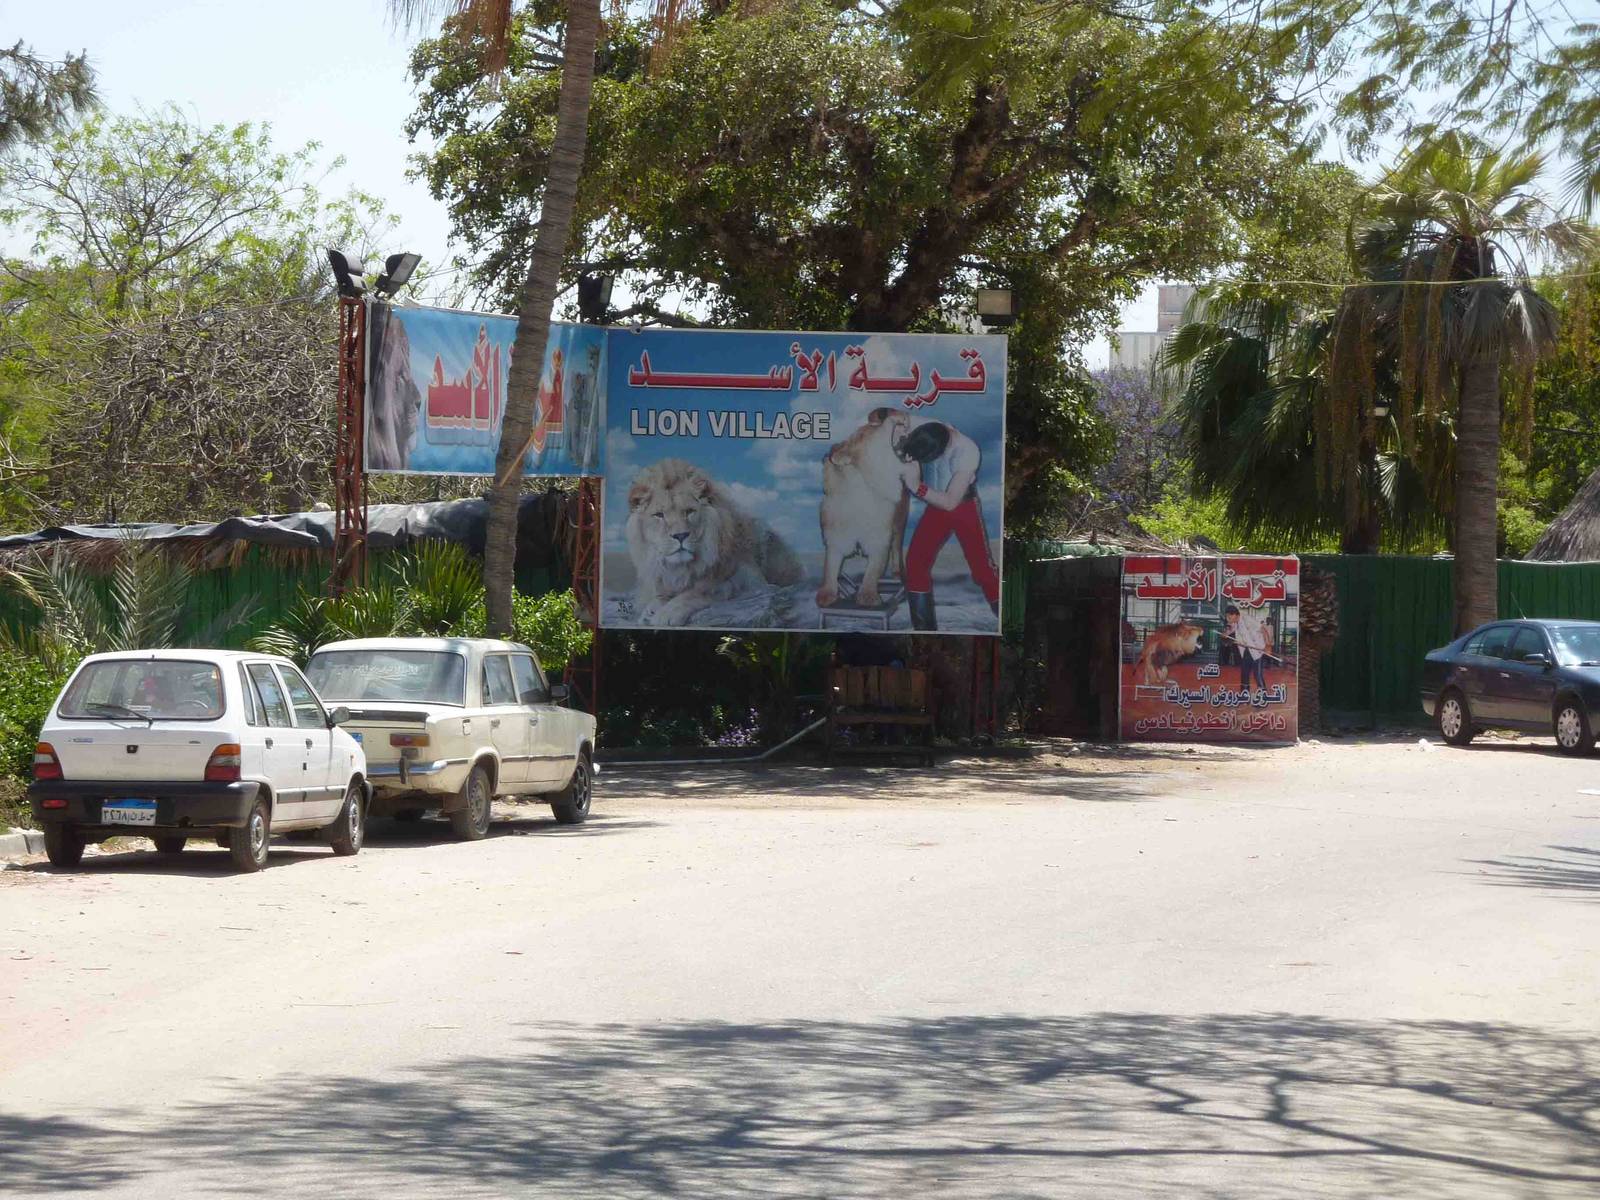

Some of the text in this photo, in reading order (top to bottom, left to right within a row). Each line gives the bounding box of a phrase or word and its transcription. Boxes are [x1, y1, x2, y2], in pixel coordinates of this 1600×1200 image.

[628, 342, 987, 407] قرية الأسد
[630, 408, 831, 440] LION VILLAGE
[1136, 562, 1286, 608] قرية الأسد
[1197, 664, 1220, 679] تقدم
[1166, 685, 1211, 708] السيرك
[1212, 685, 1250, 706] عروض
[1240, 710, 1286, 733] داخل
